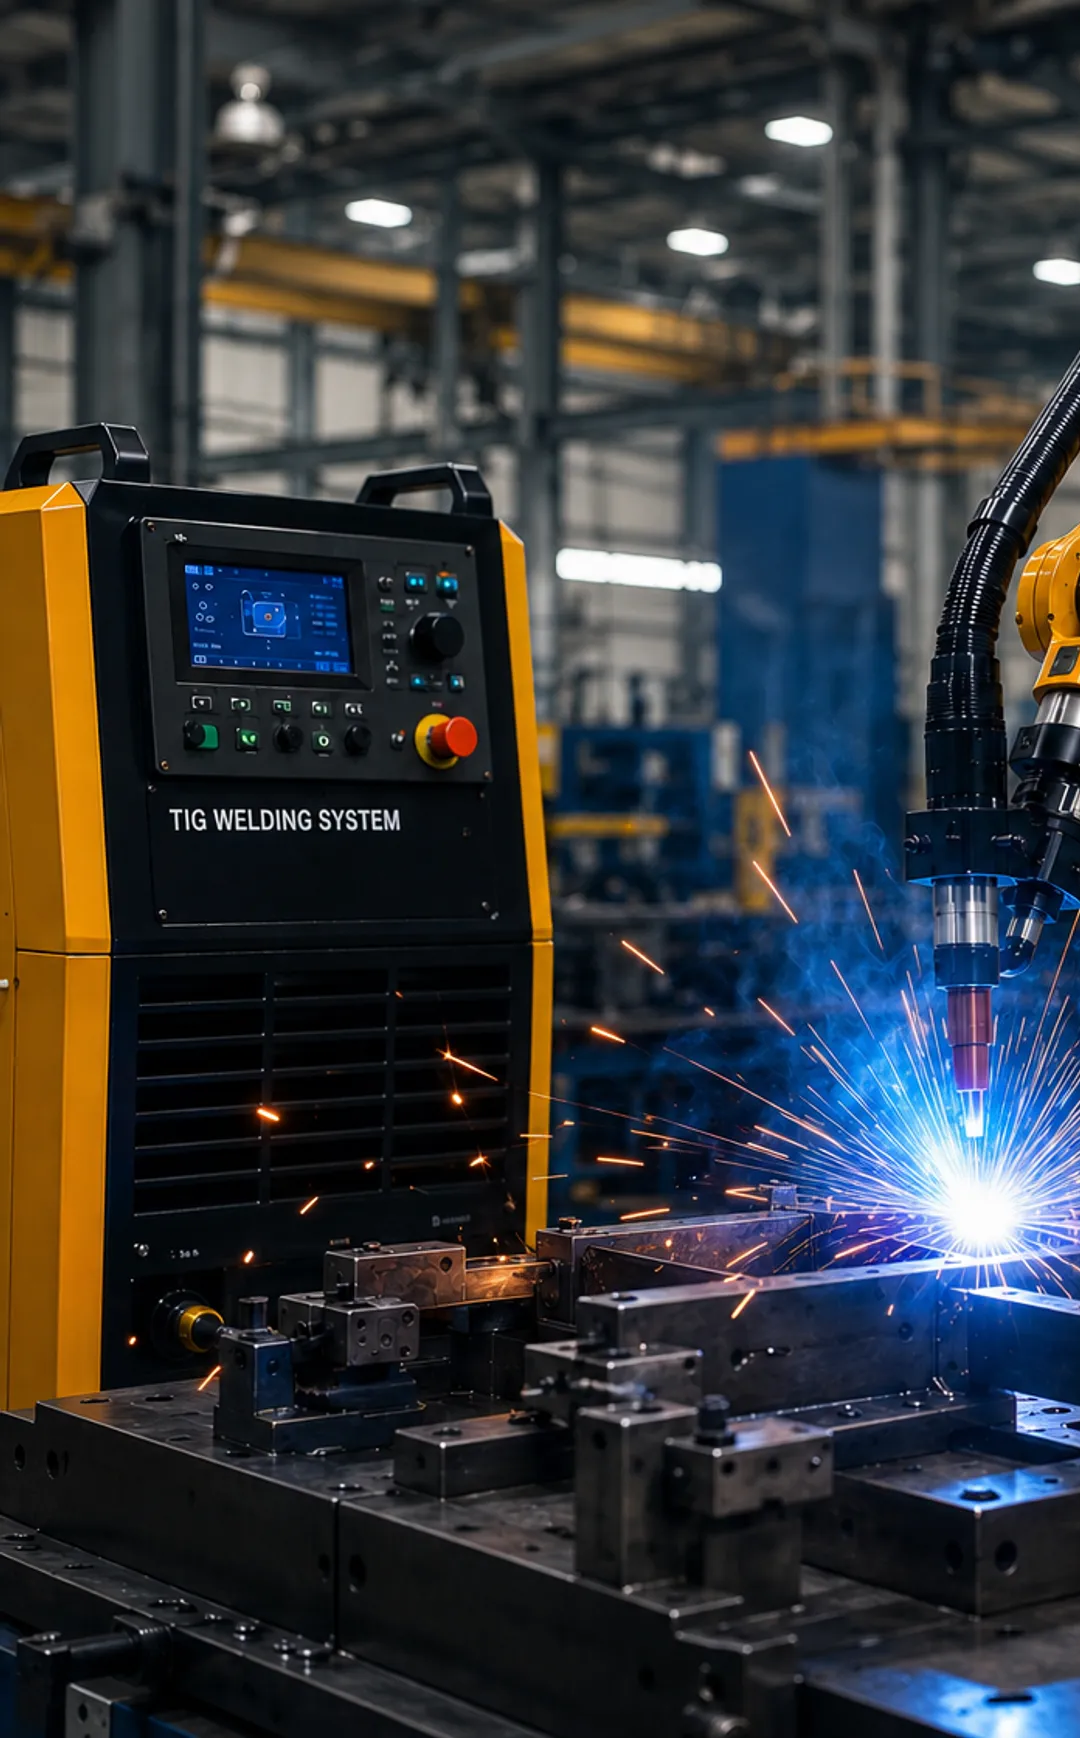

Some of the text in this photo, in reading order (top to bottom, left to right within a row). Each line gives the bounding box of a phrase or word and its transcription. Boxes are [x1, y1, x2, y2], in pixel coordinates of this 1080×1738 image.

[168, 808, 401, 832] TIG WELDING SYSTEM
